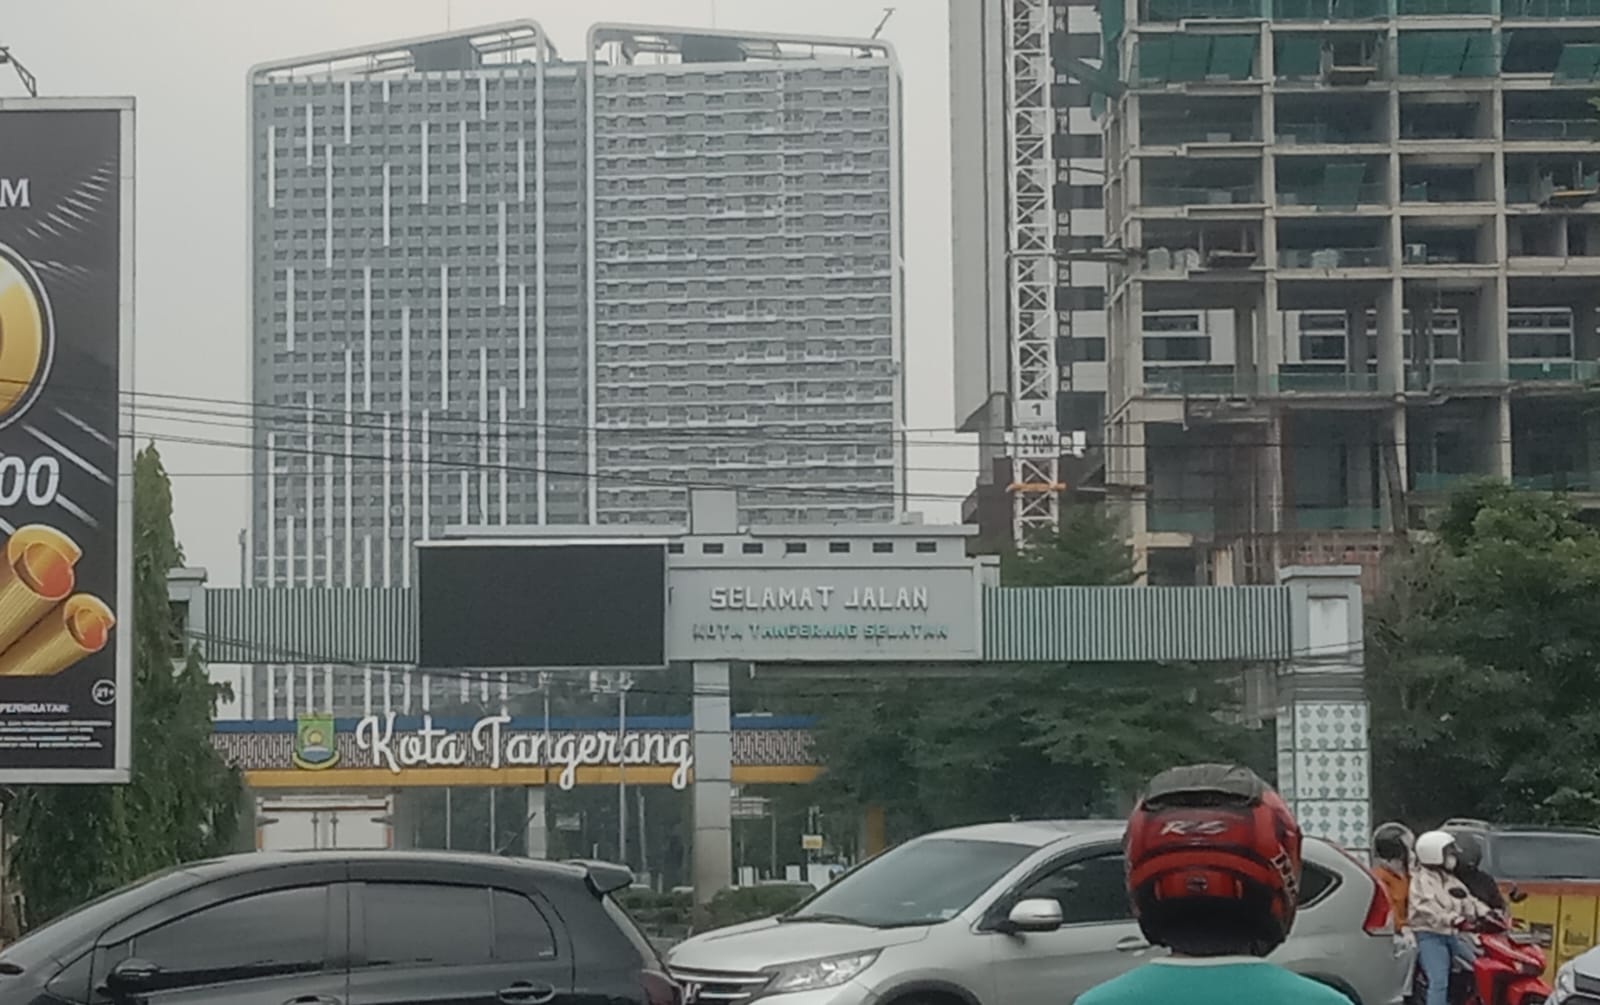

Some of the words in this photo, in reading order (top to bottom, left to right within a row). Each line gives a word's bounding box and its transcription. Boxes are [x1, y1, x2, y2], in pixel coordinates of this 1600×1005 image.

[0, 455, 60, 506] 00
[710, 586, 834, 610] SELAMAT
[844, 586, 928, 611] JALAN
[692, 624, 743, 641] KOTA
[749, 624, 857, 641] TANGERANG
[863, 624, 948, 641] SELATAN
[355, 711, 467, 774] Kota
[471, 715, 693, 791] Tangerang
